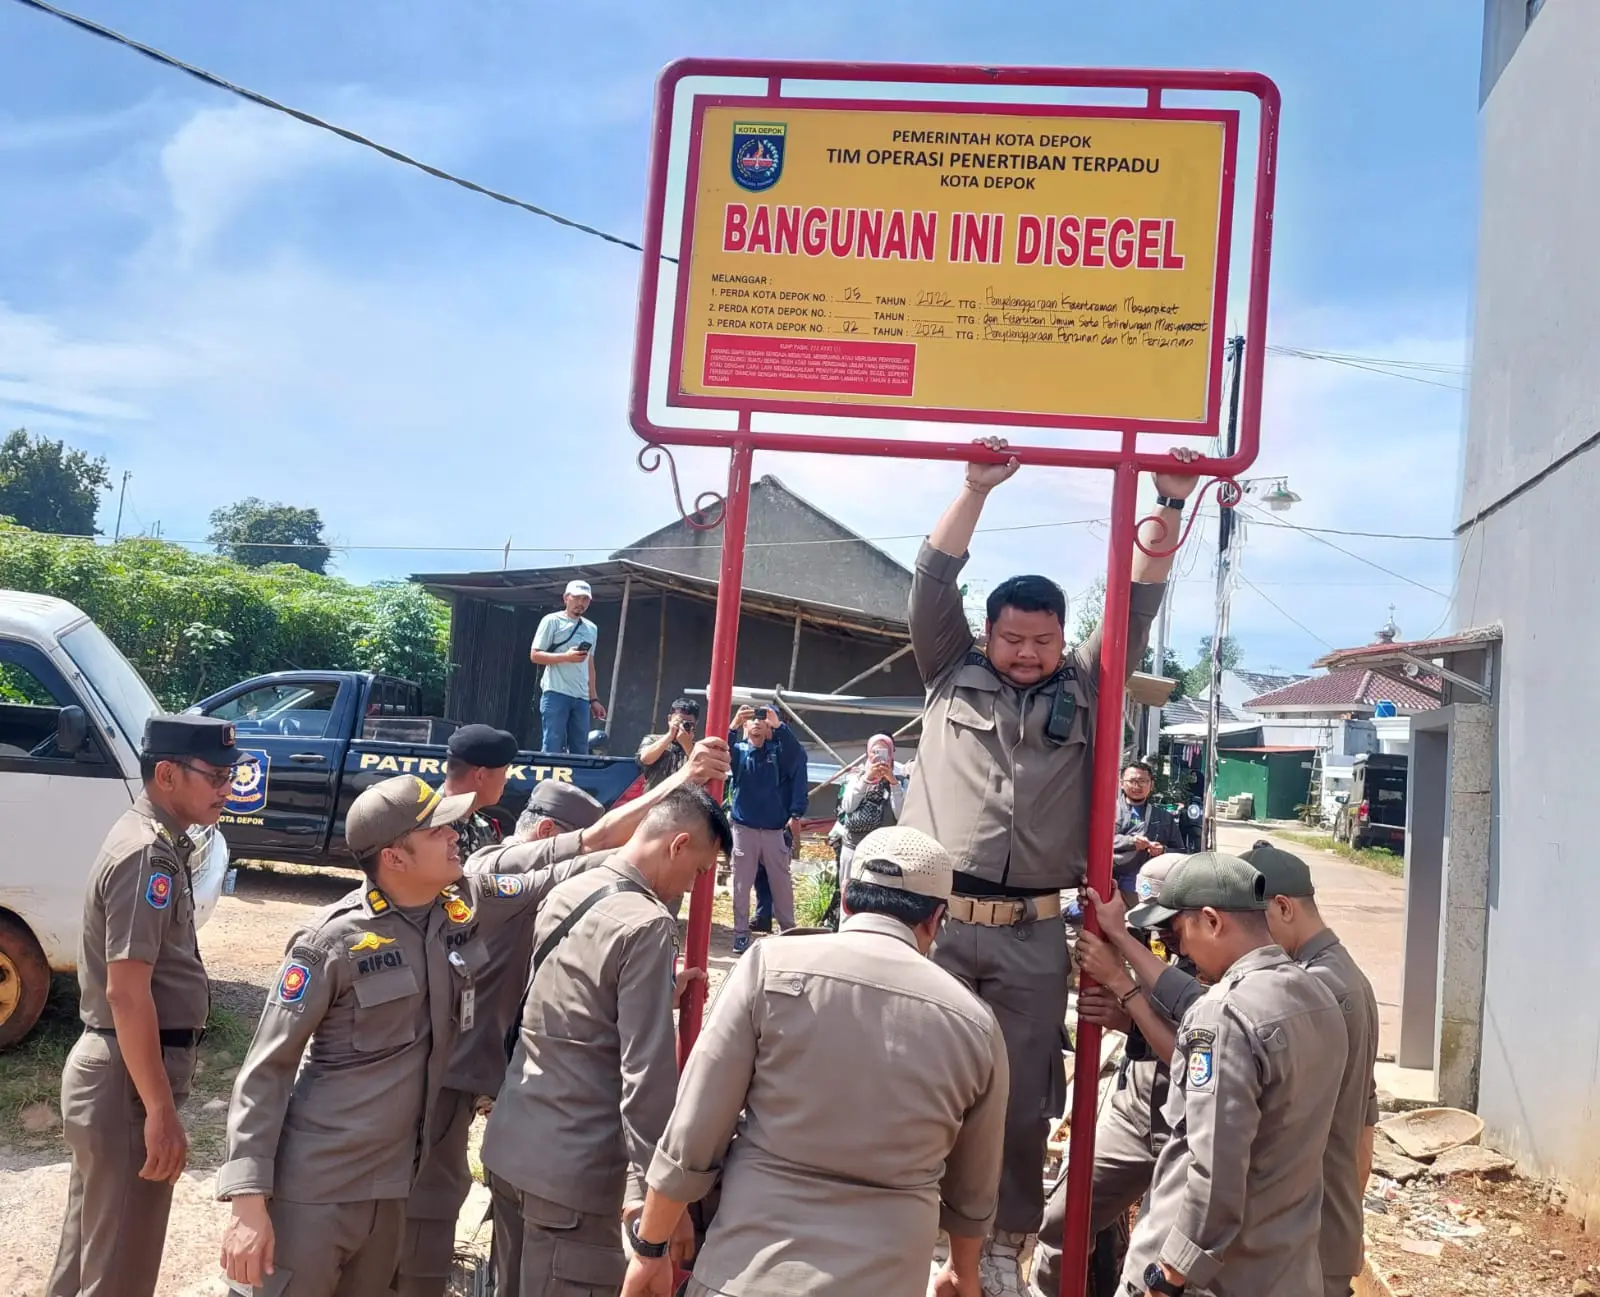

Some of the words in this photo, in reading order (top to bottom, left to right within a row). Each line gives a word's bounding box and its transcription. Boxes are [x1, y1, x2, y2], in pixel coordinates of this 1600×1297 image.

[758, 127, 783, 135] DEPOK
[892, 129, 991, 146] PEMERINTAH
[995, 133, 1035, 147] KOTA
[1039, 134, 1092, 149] DEPOK
[826, 148, 861, 164] TIM
[866, 149, 944, 168] OPERASI
[950, 152, 1067, 172] PENERTIBAN
[1071, 156, 1160, 174] TERPADU
[940, 174, 979, 189] KOTA
[983, 176, 1036, 191] DEPOK
[721, 203, 938, 262] BANGUNAN
[948, 211, 1004, 265] INI
[1014, 214, 1186, 271] DISEGEL
[711, 273, 768, 286] MELANGGAR
[719, 288, 750, 299] PERDA
[752, 290, 777, 300] KOTA
[779, 291, 810, 302] DEPOK
[875, 296, 906, 306] TAHUN
[958, 300, 976, 310] TTG
[717, 304, 748, 314] PERDA
[750, 305, 775, 316] KOTA
[778, 307, 808, 318] DEPOK
[873, 311, 905, 322] TAHUN
[956, 315, 975, 326] TTG
[716, 319, 747, 330] PERDA
[749, 320, 774, 331] KOTA
[776, 322, 807, 332] DEPOK
[872, 326, 904, 338] TAHUN
[955, 330, 975, 341] TTG
[217, 815, 235, 824] OTA
[236, 816, 265, 826] DEPOK
[357, 950, 403, 975] RIFQI
